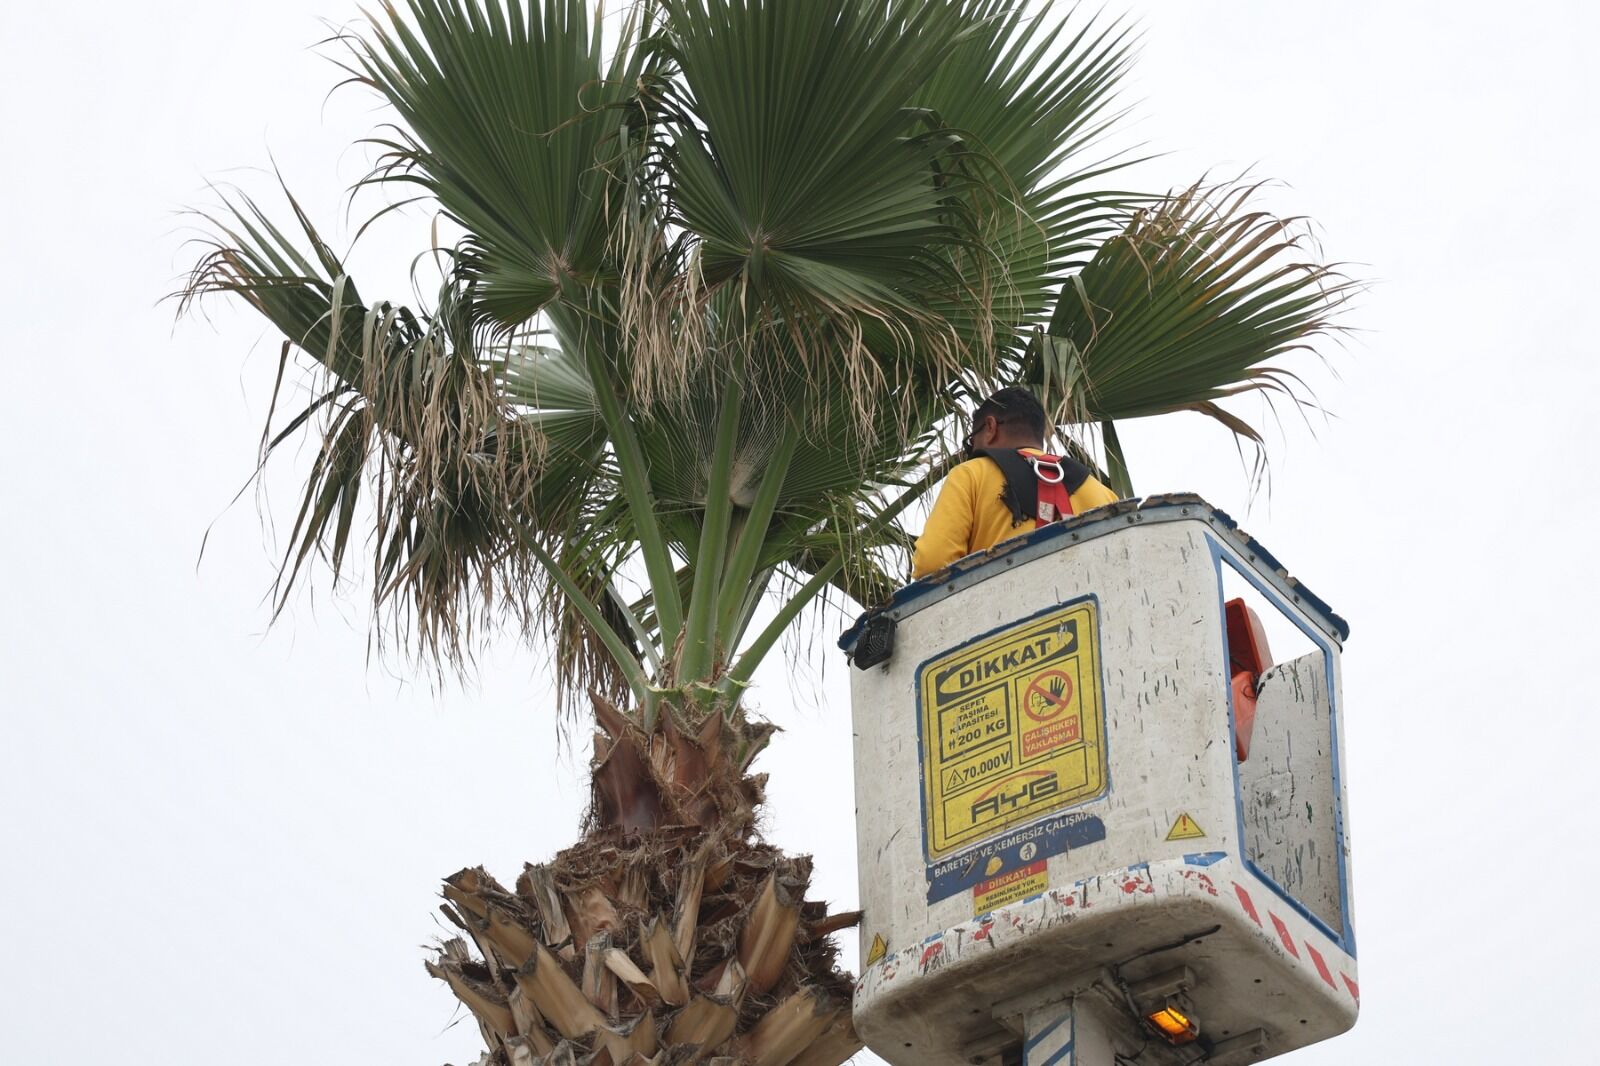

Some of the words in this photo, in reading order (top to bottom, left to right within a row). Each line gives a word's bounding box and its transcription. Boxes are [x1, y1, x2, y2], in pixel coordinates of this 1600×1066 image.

[959, 637, 1051, 688] DİKKAT
[960, 696, 985, 712] SEPET
[958, 729, 981, 746] 200
[986, 719, 1005, 735] KG
[963, 751, 1010, 781] 70.000V
[971, 772, 1058, 823] AYG
[980, 845, 993, 858] VE
[994, 825, 1044, 851] KEMERSİZ
